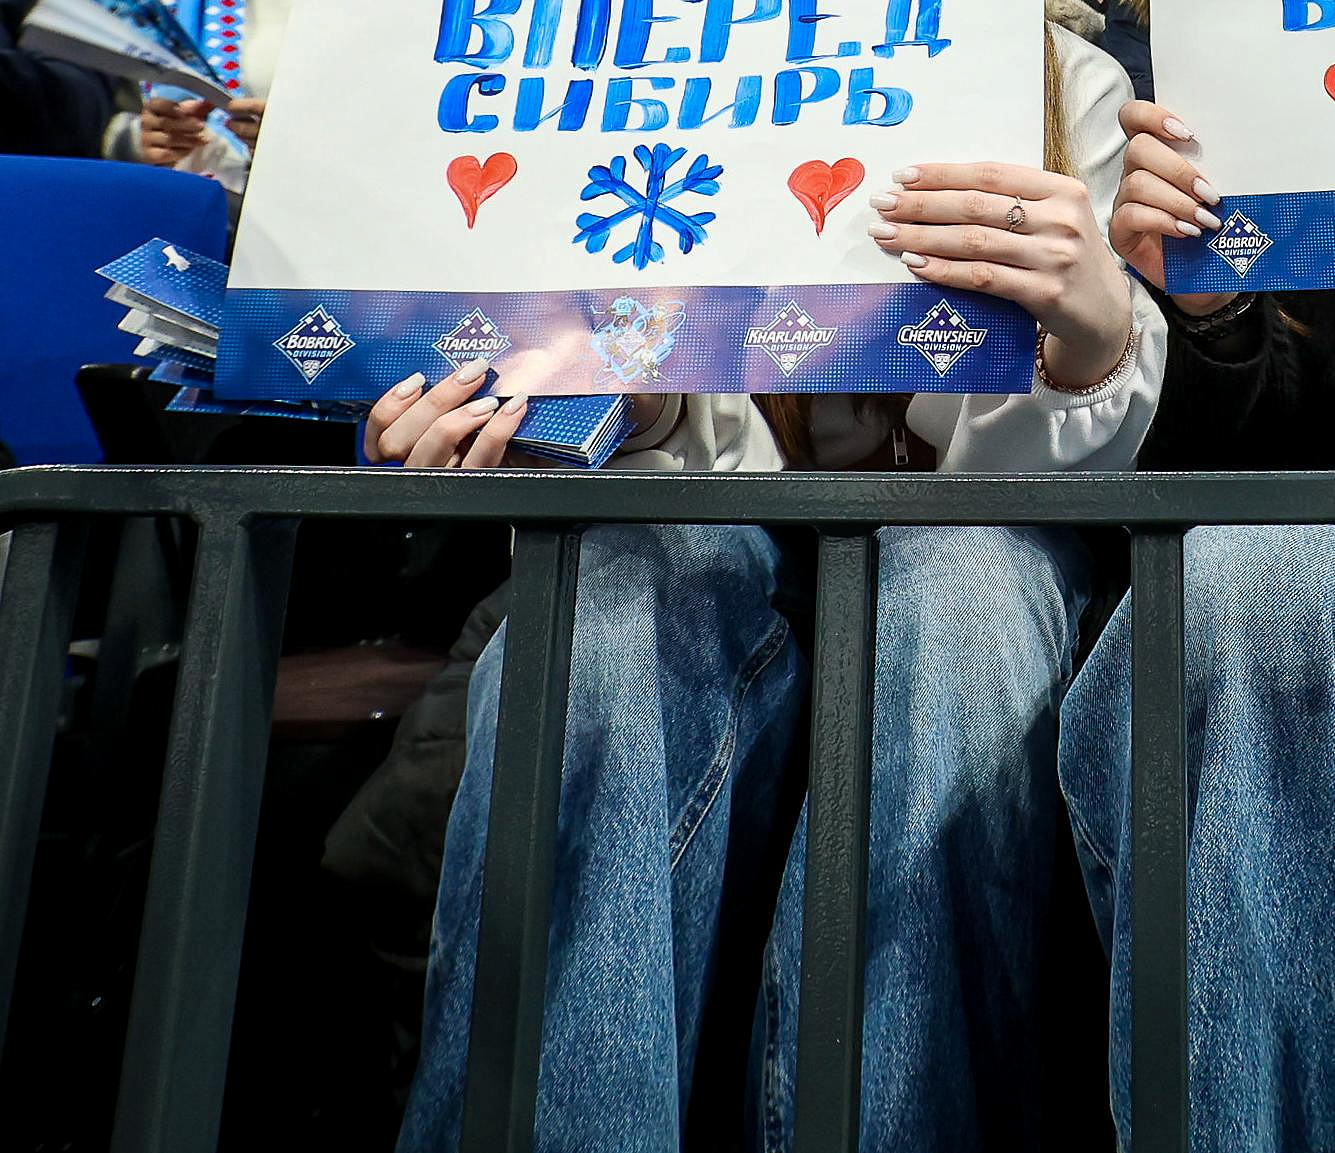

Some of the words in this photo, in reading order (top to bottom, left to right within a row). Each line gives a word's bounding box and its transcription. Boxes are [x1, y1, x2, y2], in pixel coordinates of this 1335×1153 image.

[438, 66, 915, 134] СИБИРЬ
[1218, 235, 1264, 249] BOBROV
[1224, 248, 1258, 256] DIVISION
[286, 334, 344, 350] BOBROV
[748, 328, 833, 345] KHARLAMOV
[900, 328, 984, 344] CHERNYSHEV
[443, 336, 504, 351] TARASOV
[770, 343, 810, 352] DIVISION
[923, 343, 962, 352] DIVISION
[292, 349, 334, 358] DIVISION
[451, 351, 492, 359] DIVISION
